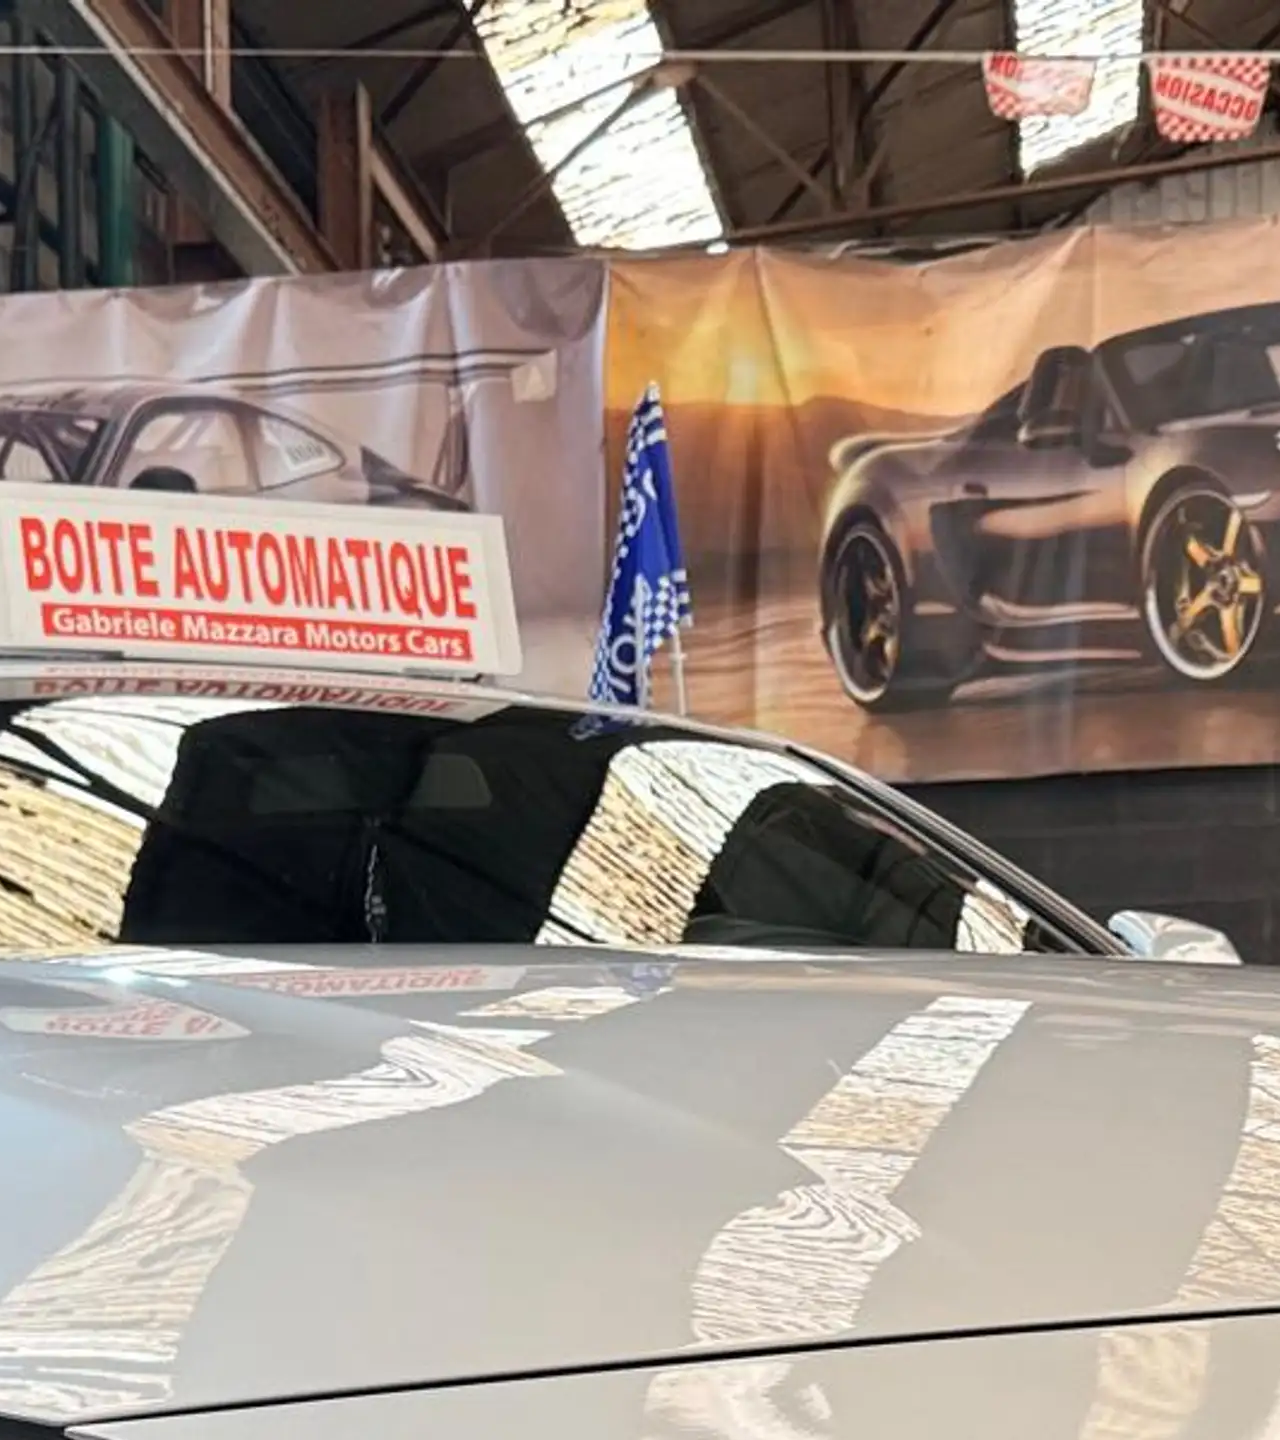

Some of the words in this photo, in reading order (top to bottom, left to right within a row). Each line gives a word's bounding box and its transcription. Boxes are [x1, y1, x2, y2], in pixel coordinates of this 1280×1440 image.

[20, 517, 160, 597] BOITE
[174, 527, 476, 619] AUTOMATIQUE
[53, 607, 176, 639] Gabriele
[183, 616, 298, 647] Mazzara
[306, 622, 401, 653] Motors
[405, 628, 464, 658] Cars
